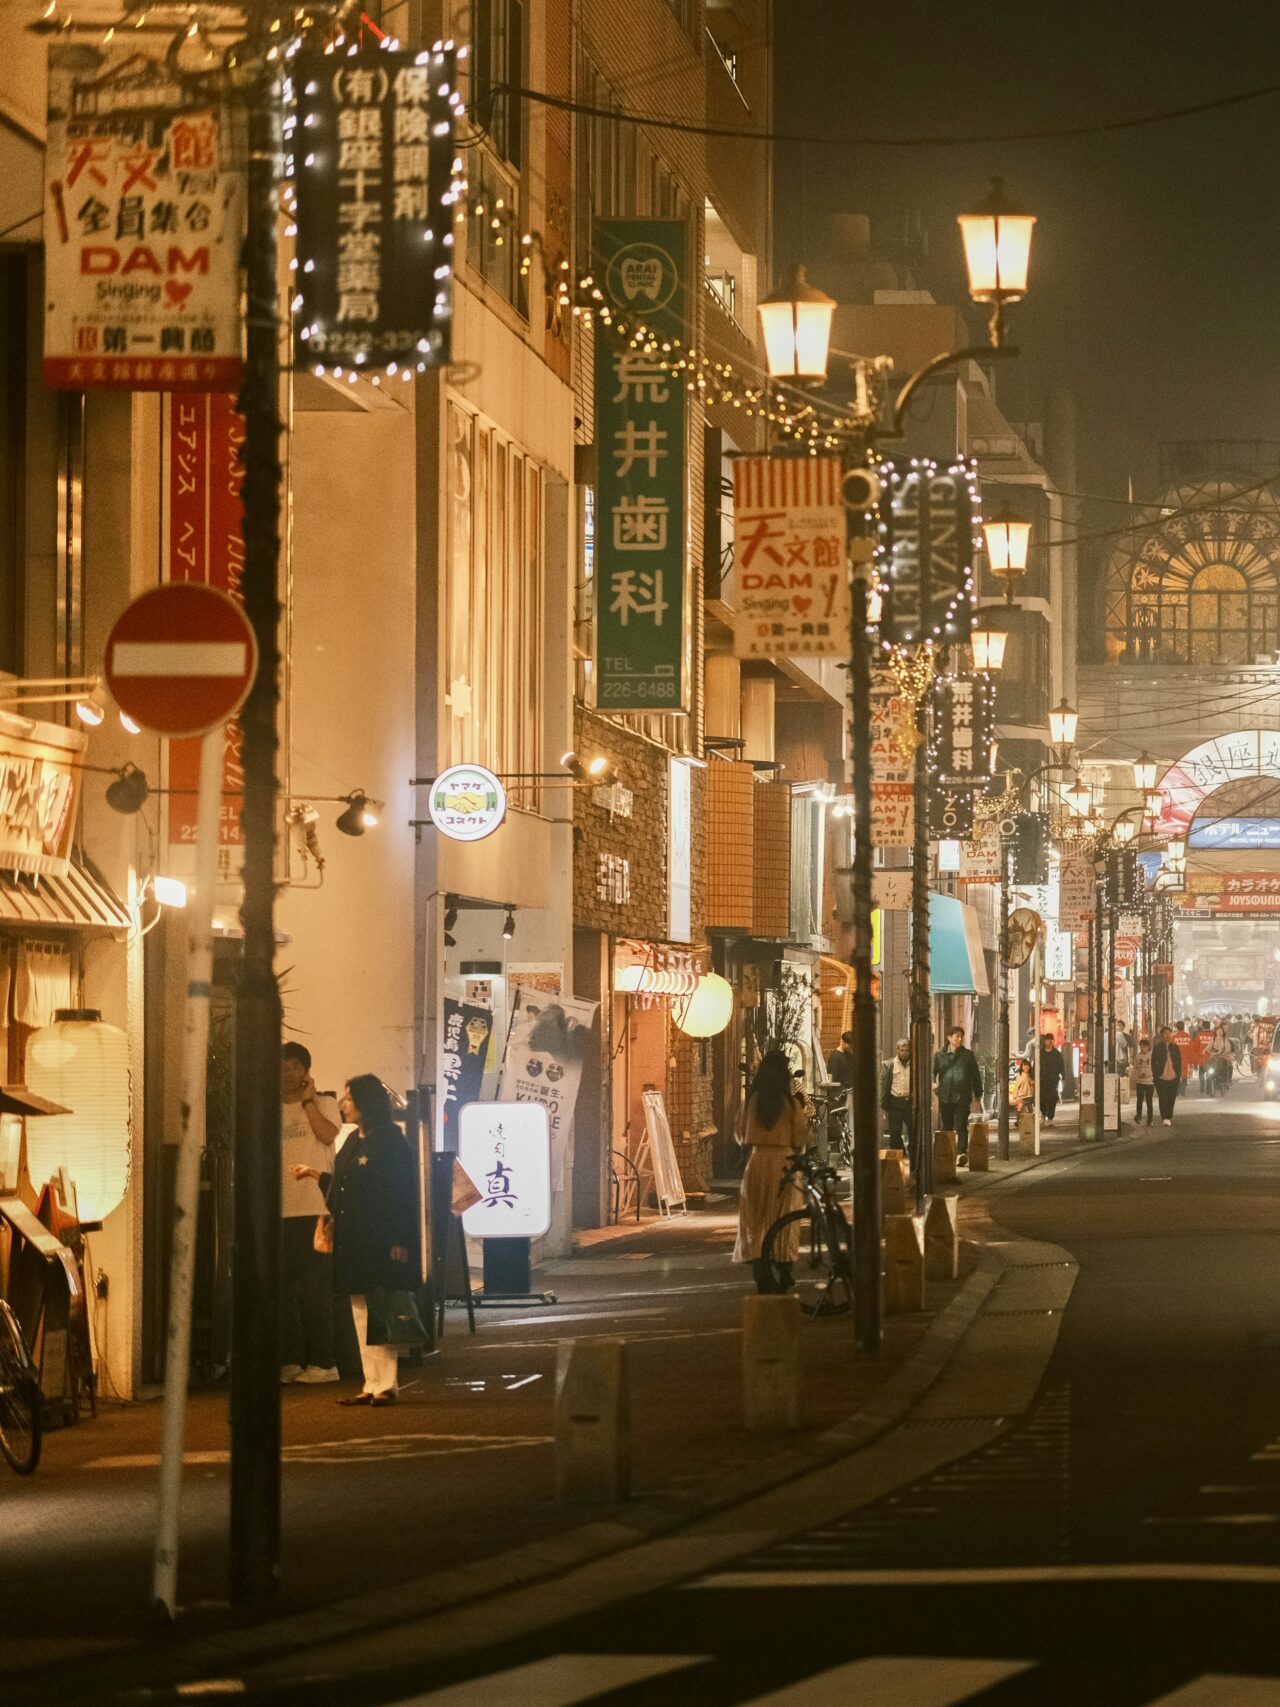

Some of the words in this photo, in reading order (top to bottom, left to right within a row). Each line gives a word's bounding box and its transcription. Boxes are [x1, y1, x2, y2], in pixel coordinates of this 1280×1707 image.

[77, 196, 212, 240] 全員集合
[80, 246, 209, 275] DAM
[627, 264, 656, 274] ARAI
[609, 350, 670, 627] 荒井歯科
[739, 512, 840, 570] 天文館
[928, 475, 959, 604] GINZA
[742, 574, 813, 590] DAM
[604, 658, 634, 672] TEL
[603, 681, 675, 699] 226-6488
[952, 681, 974, 771] 荒井歯科
[445, 815, 487, 825] コネクト
[1203, 823, 1241, 836] ホテル
[966, 851, 998, 859] DAM
[482, 1160, 519, 1209] 真
